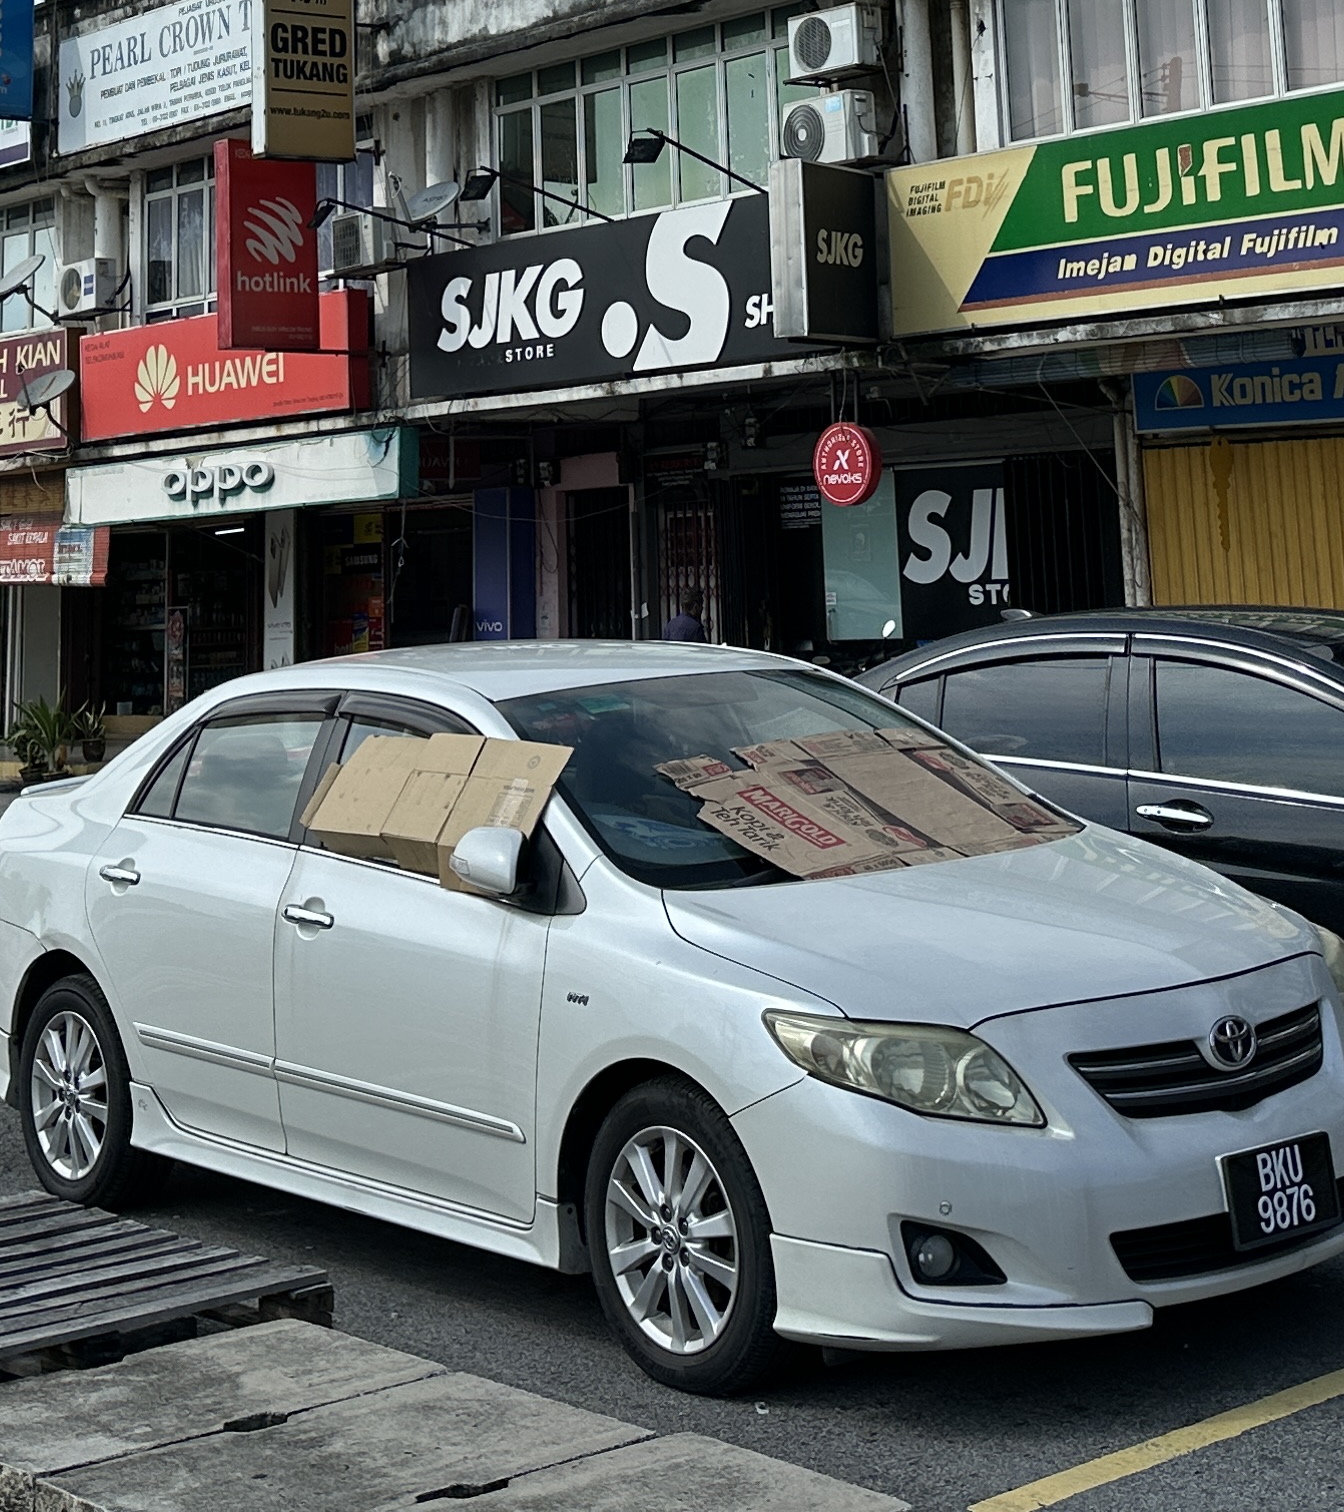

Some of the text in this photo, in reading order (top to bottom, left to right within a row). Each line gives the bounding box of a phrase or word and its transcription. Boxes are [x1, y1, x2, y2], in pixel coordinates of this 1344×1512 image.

[178, 1, 203, 16] PEJABAT
[89, 31, 152, 80] PEARL
[159, 5, 232, 57] CROWN
[270, 22, 347, 59] GRED
[270, 56, 348, 84] TUKANG
[908, 194, 939, 206] DIGITAL
[910, 180, 946, 195] FUJIFILM
[906, 203, 942, 218] IMAGING
[816, 228, 864, 268] SJKG
[1058, 225, 1338, 280] Imejan Digital Fujifilm
[236, 270, 312, 294] hotlink
[436, 257, 585, 353] SJKG
[16, 339, 62, 370] KIAN
[504, 344, 555, 363] STORE
[187, 352, 284, 395] HUAWEI
[1211, 368, 1322, 407] Konica
[851, 441, 864, 468] STORE
[161, 460, 275, 506] oppo
[345, 554, 378, 567] SAMSUNG
[476, 620, 503, 633] vivo
[709, 805, 783, 853] Teh Tarik
[729, 804, 786, 842] Kopi &
[744, 789, 842, 847] MARIGOLD
[1256, 1144, 1303, 1192] BKU
[1258, 1184, 1316, 1233] 9876
